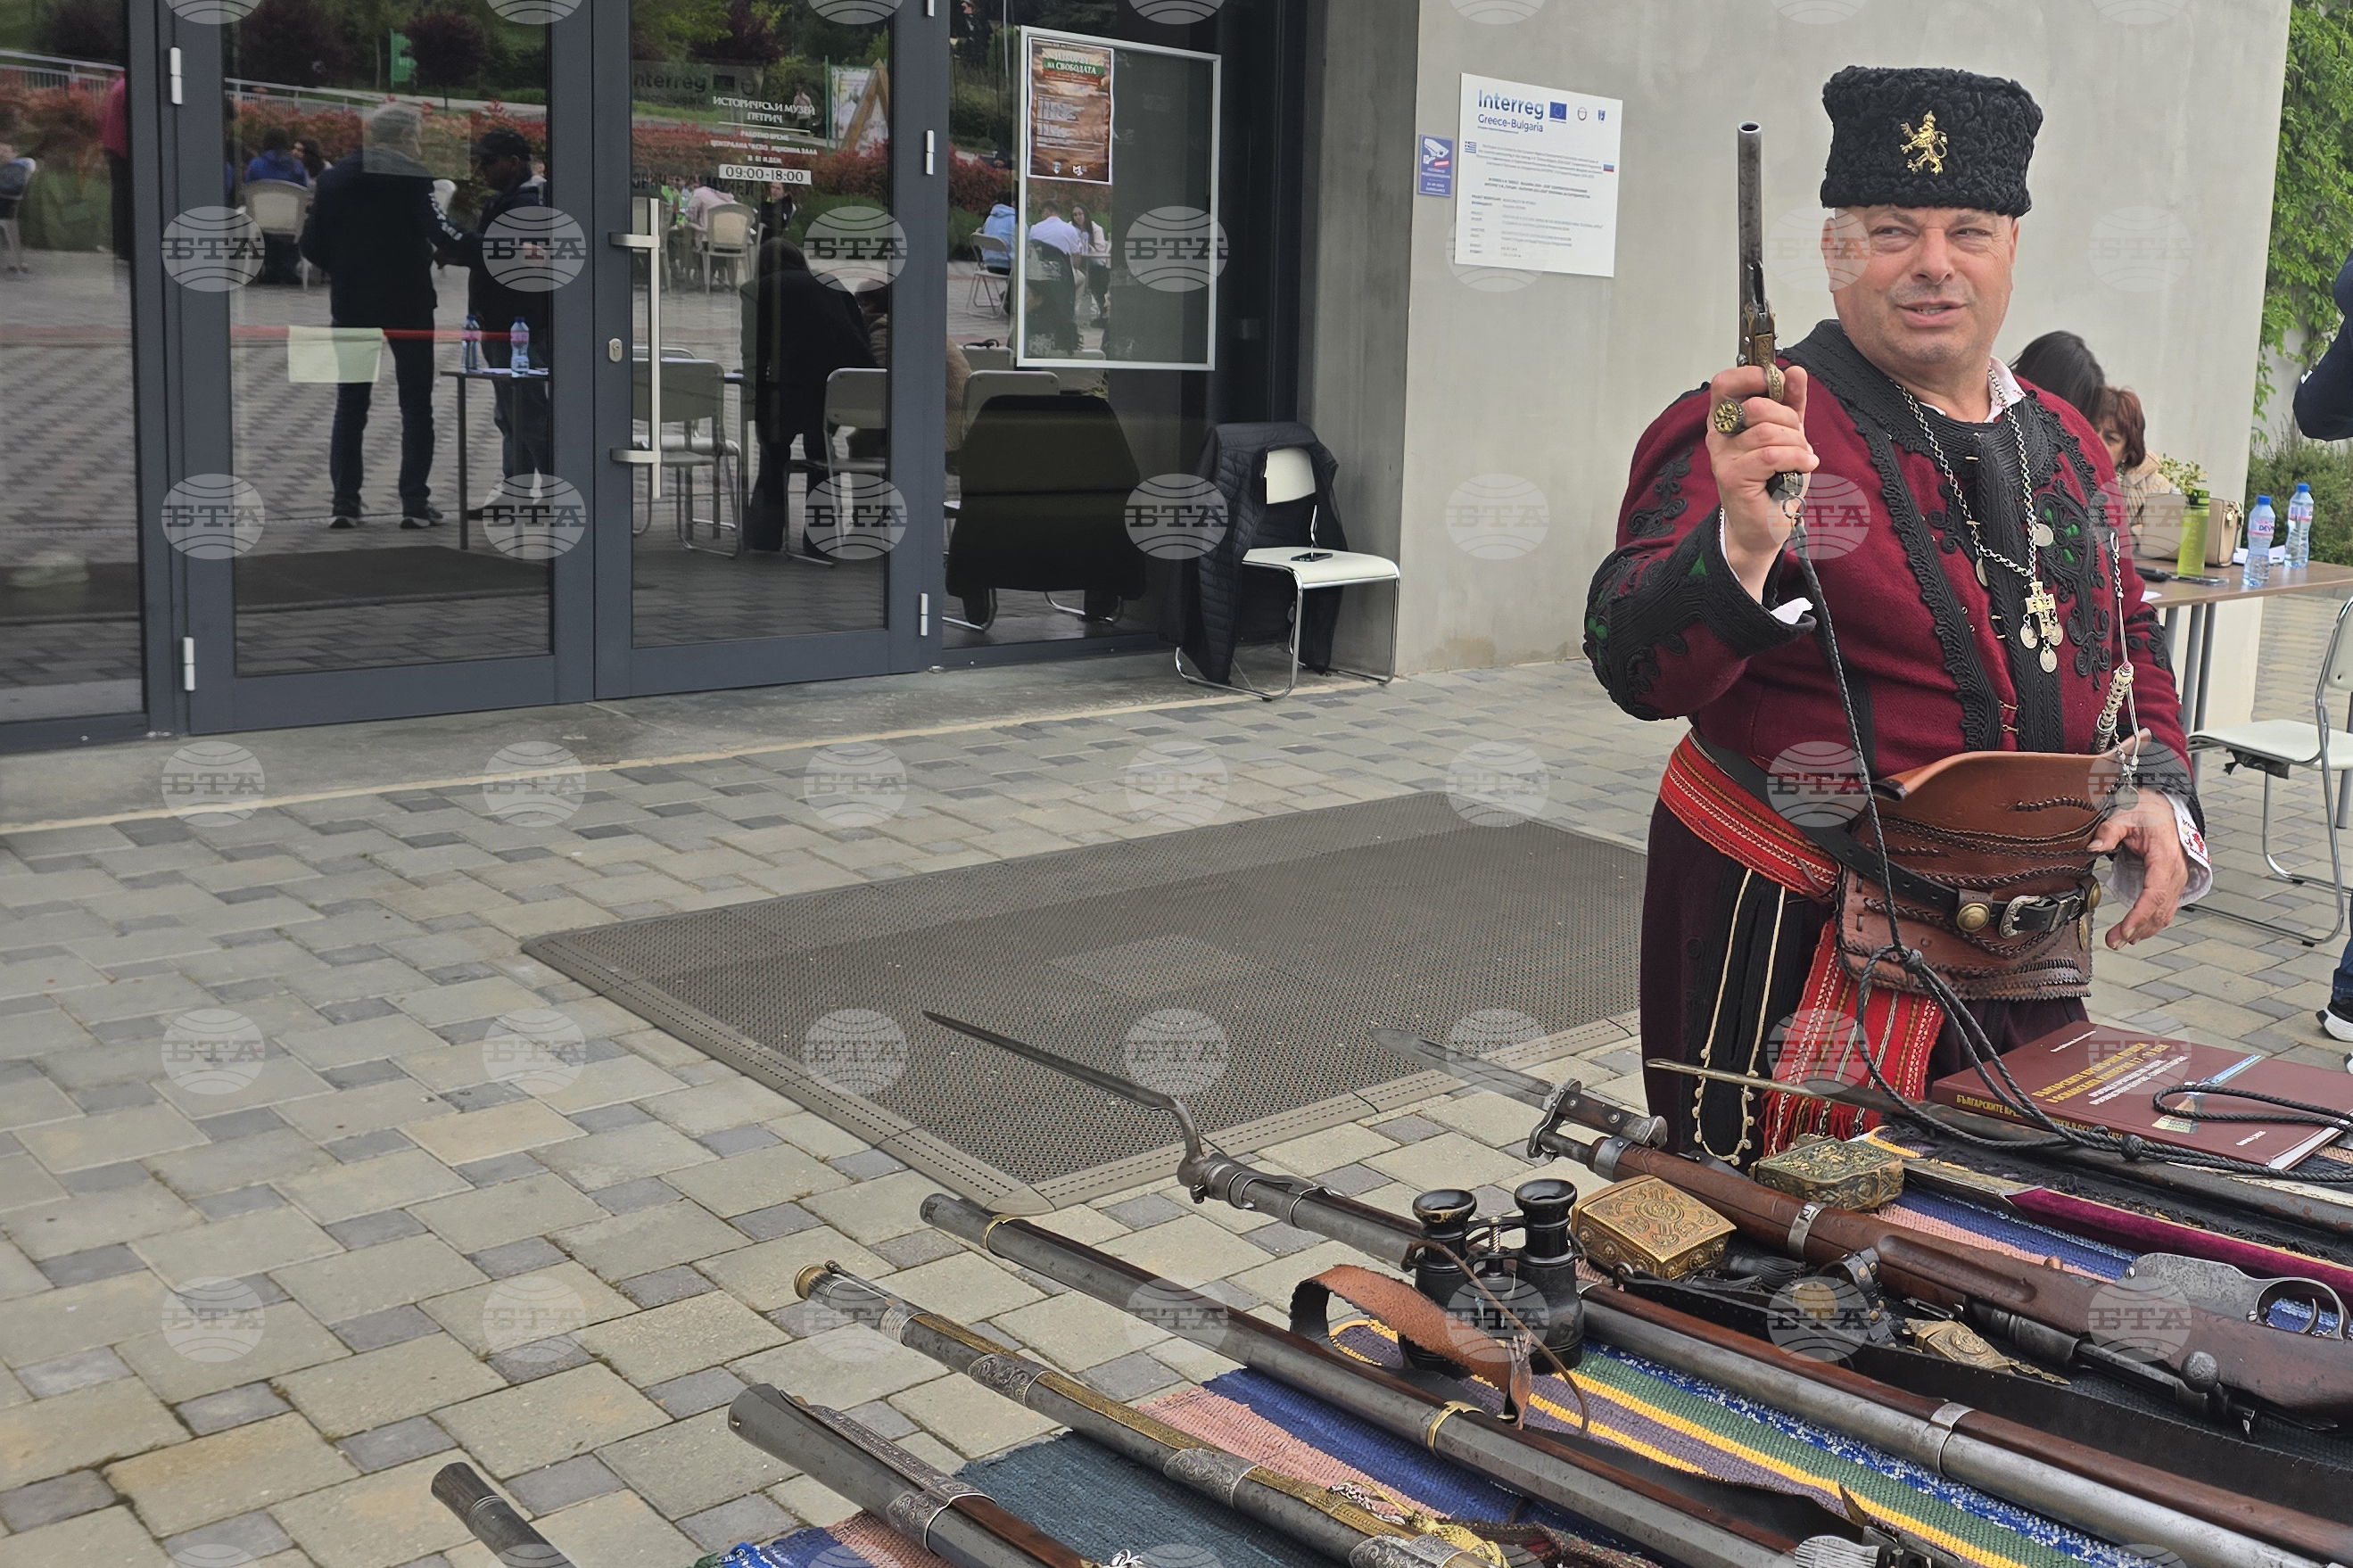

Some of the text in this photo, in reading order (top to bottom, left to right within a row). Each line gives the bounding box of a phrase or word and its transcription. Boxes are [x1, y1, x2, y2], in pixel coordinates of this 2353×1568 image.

[1056, 62, 1097, 75] СВОБОДАТА
[633, 71, 706, 94] nterreg
[785, 103, 816, 116] МУЗЕЙ
[1478, 89, 1544, 120] Interreg
[747, 111, 783, 124] ПЕТРИЧ
[1477, 113, 1544, 133] Greece-Bulgaria
[725, 166, 805, 183] 09:00-18:00
[1957, 1094, 2003, 1114] БЪЛГАРСКИТЕ
